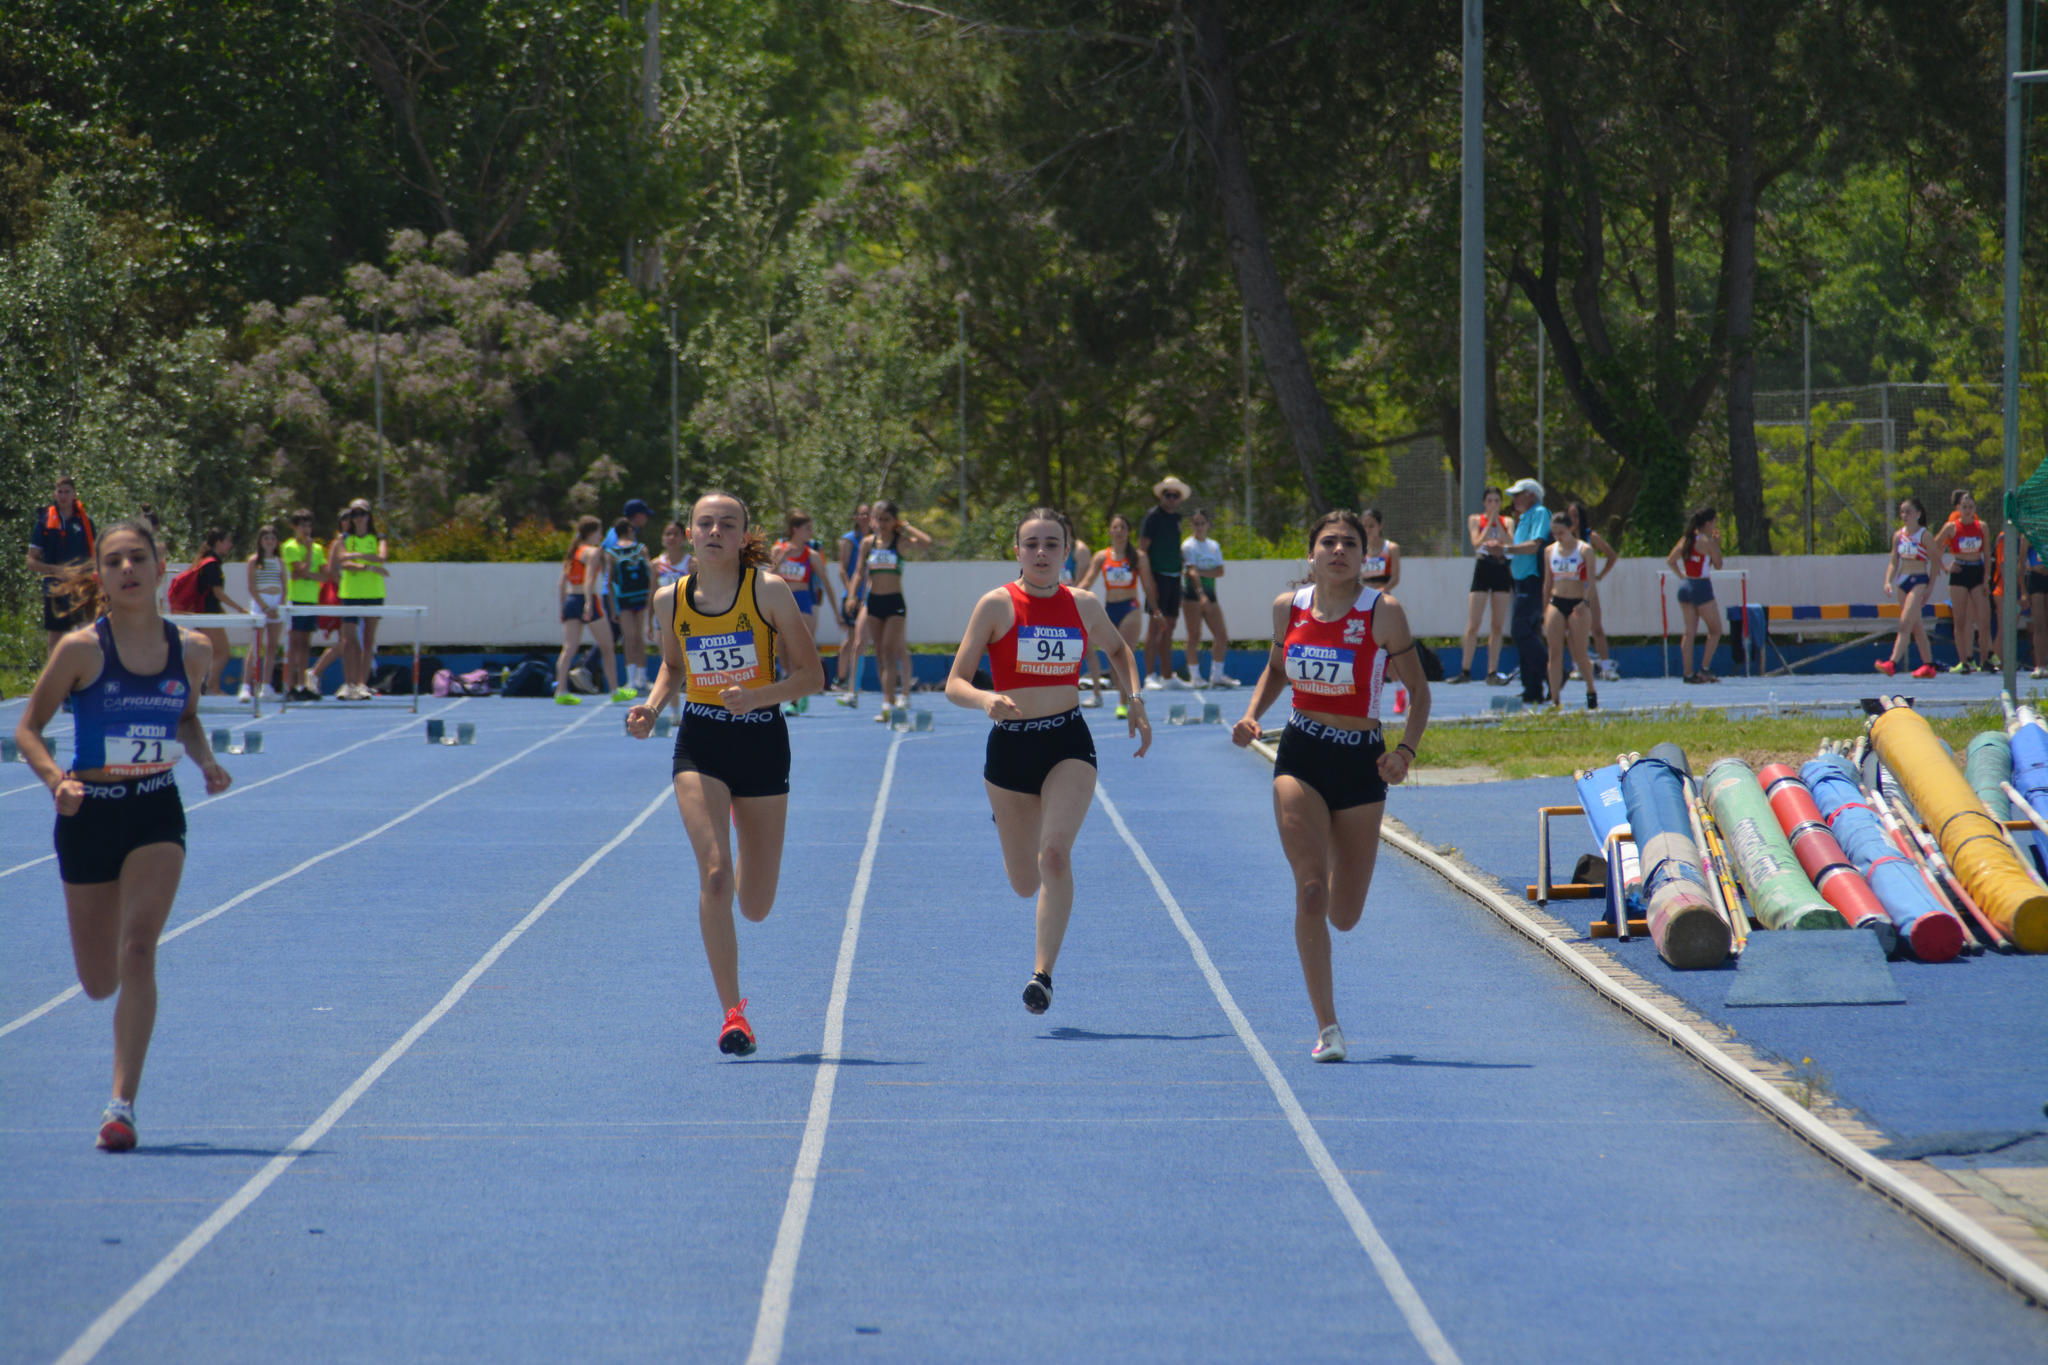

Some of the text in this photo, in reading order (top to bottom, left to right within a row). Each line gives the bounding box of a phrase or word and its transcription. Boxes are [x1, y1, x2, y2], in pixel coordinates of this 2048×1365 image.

[699, 634, 736, 649] Joma
[1033, 627, 1068, 638] Joma
[1037, 639, 1065, 661] 94
[1301, 646, 1338, 659] Joma
[699, 647, 745, 672] 135
[1020, 663, 1075, 675] mutuacat
[1297, 660, 1340, 683] 127
[1295, 681, 1351, 695] mutuacat
[686, 703, 729, 721] NIKE
[1023, 716, 1065, 732] PRO
[1320, 726, 1361, 745] PRO
[131, 740, 164, 764] 21
[84, 769, 174, 799] PRO NIKE
